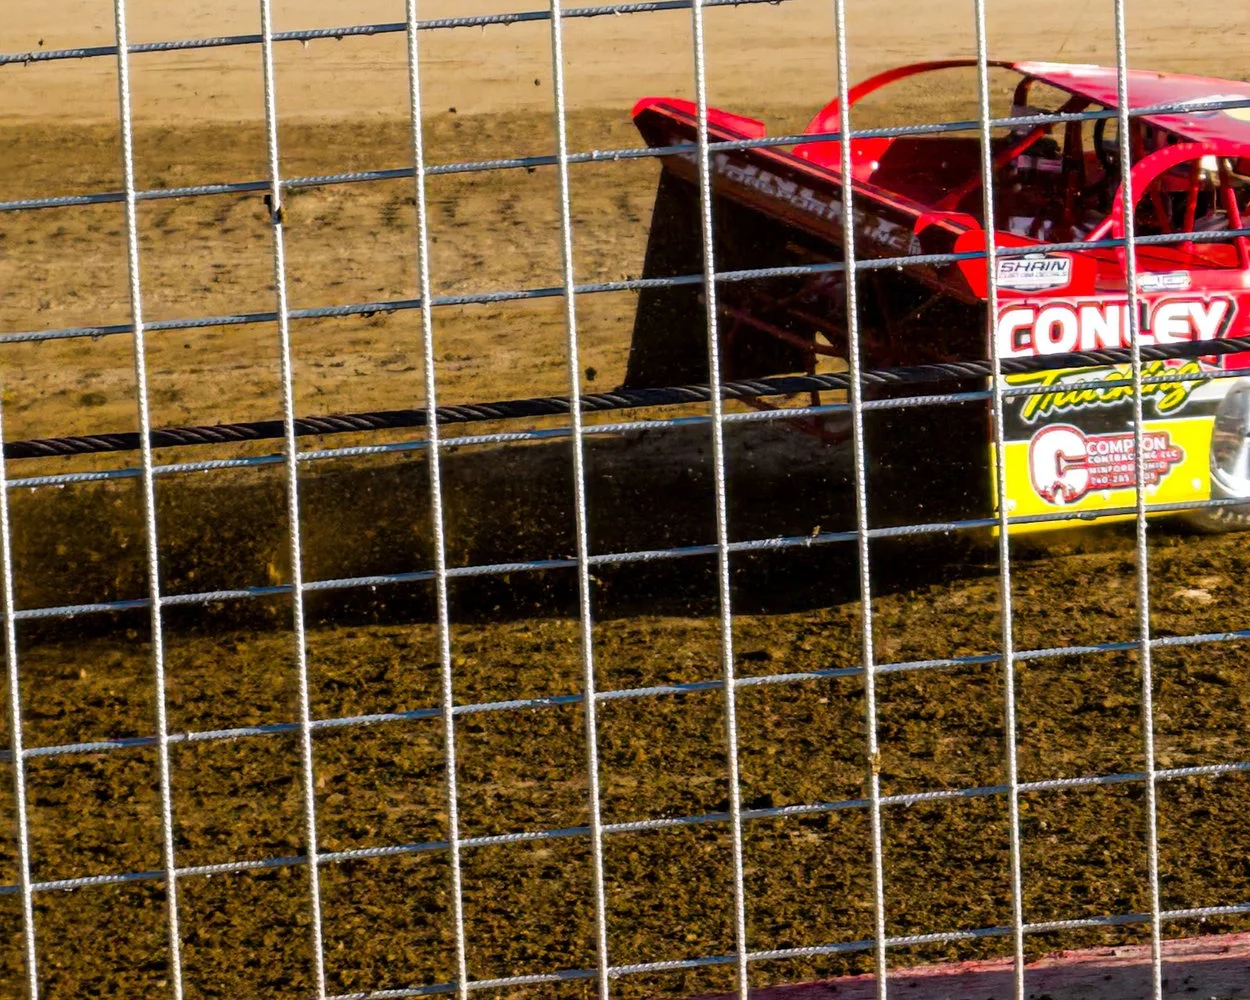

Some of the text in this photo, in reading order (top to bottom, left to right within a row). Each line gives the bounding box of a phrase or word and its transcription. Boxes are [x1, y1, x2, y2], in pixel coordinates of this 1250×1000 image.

[1000, 260, 1067, 273] SHAIN
[998, 301, 1230, 358] CONLEY
[1086, 436, 1168, 456] COMPON
